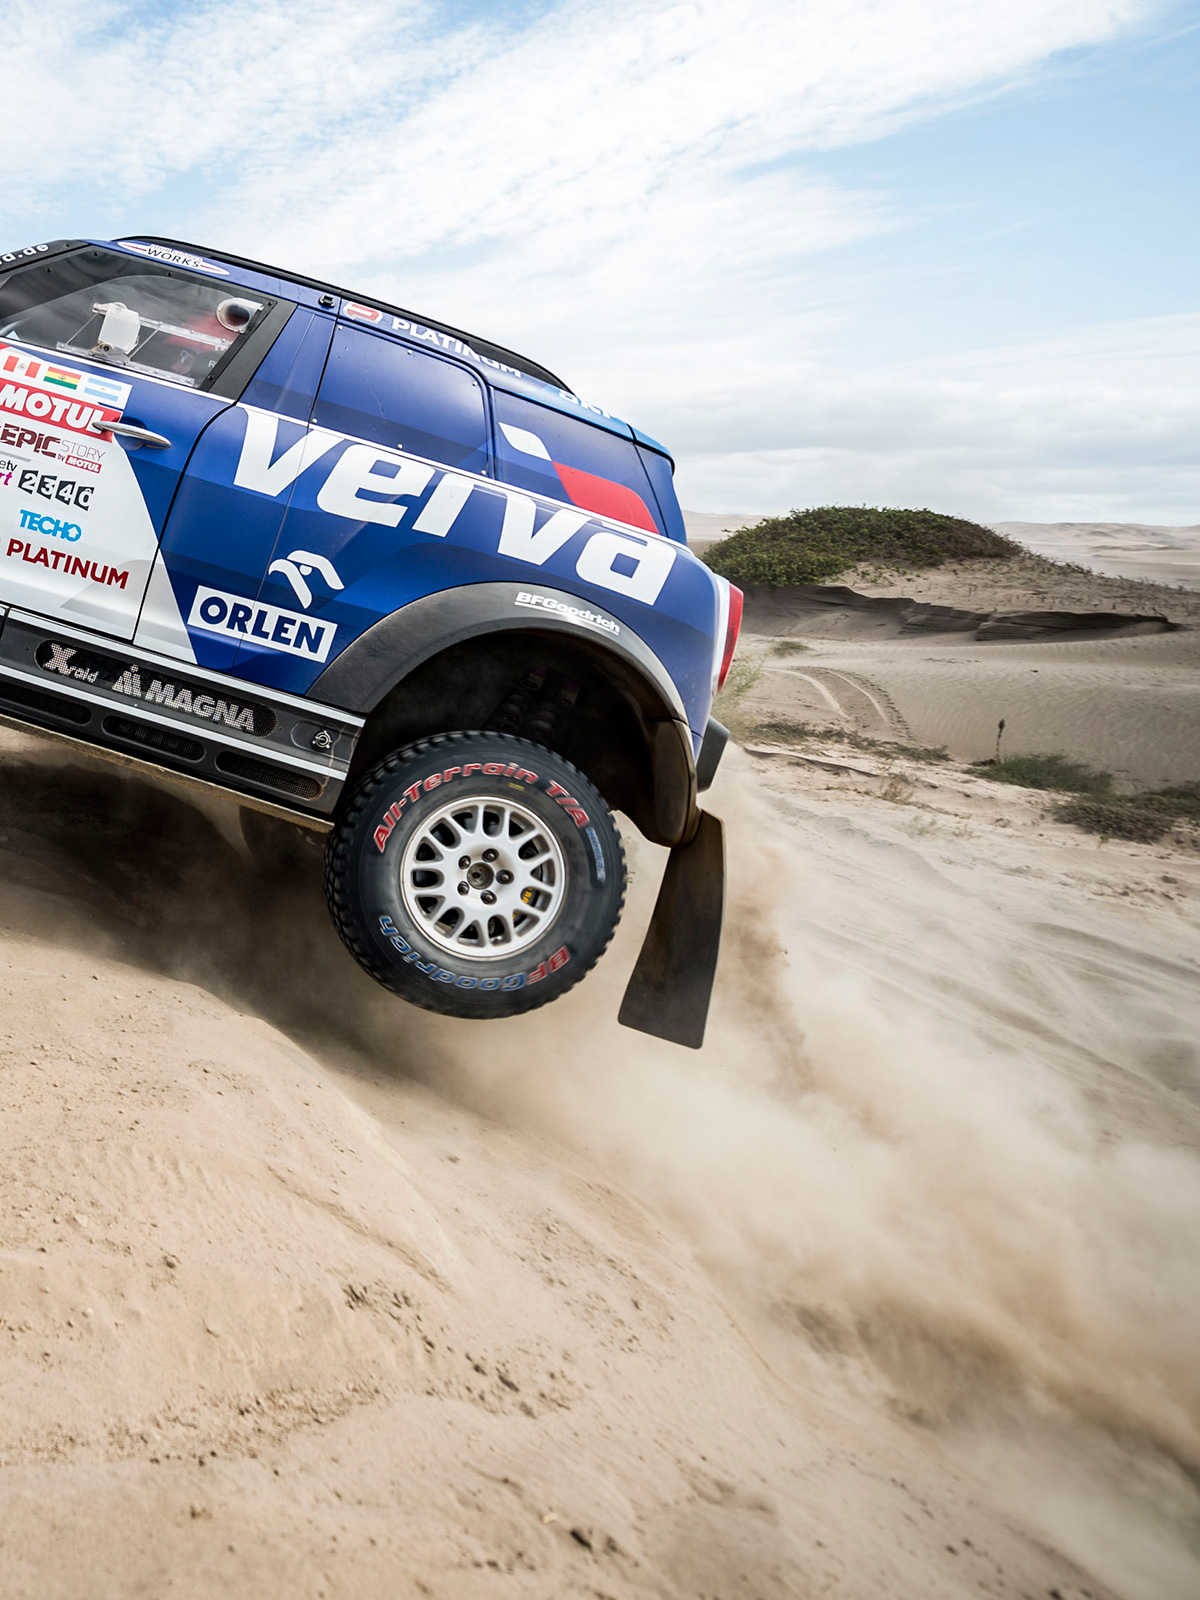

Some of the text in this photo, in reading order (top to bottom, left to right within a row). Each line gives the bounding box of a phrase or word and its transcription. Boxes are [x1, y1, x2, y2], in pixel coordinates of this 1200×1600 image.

[147, 248, 200, 268] WORKS
[57, 453, 101, 472] by MOTUL
[20, 509, 82, 542] TECHO
[233, 403, 678, 606] verva
[6, 538, 130, 589] PLATINUM
[200, 596, 326, 654] ORLEN
[515, 591, 621, 633] BFGoodrich
[144, 679, 255, 733] MAGNA
[372, 762, 540, 854] All-Terrain
[378, 914, 571, 992] BFGoodrich
